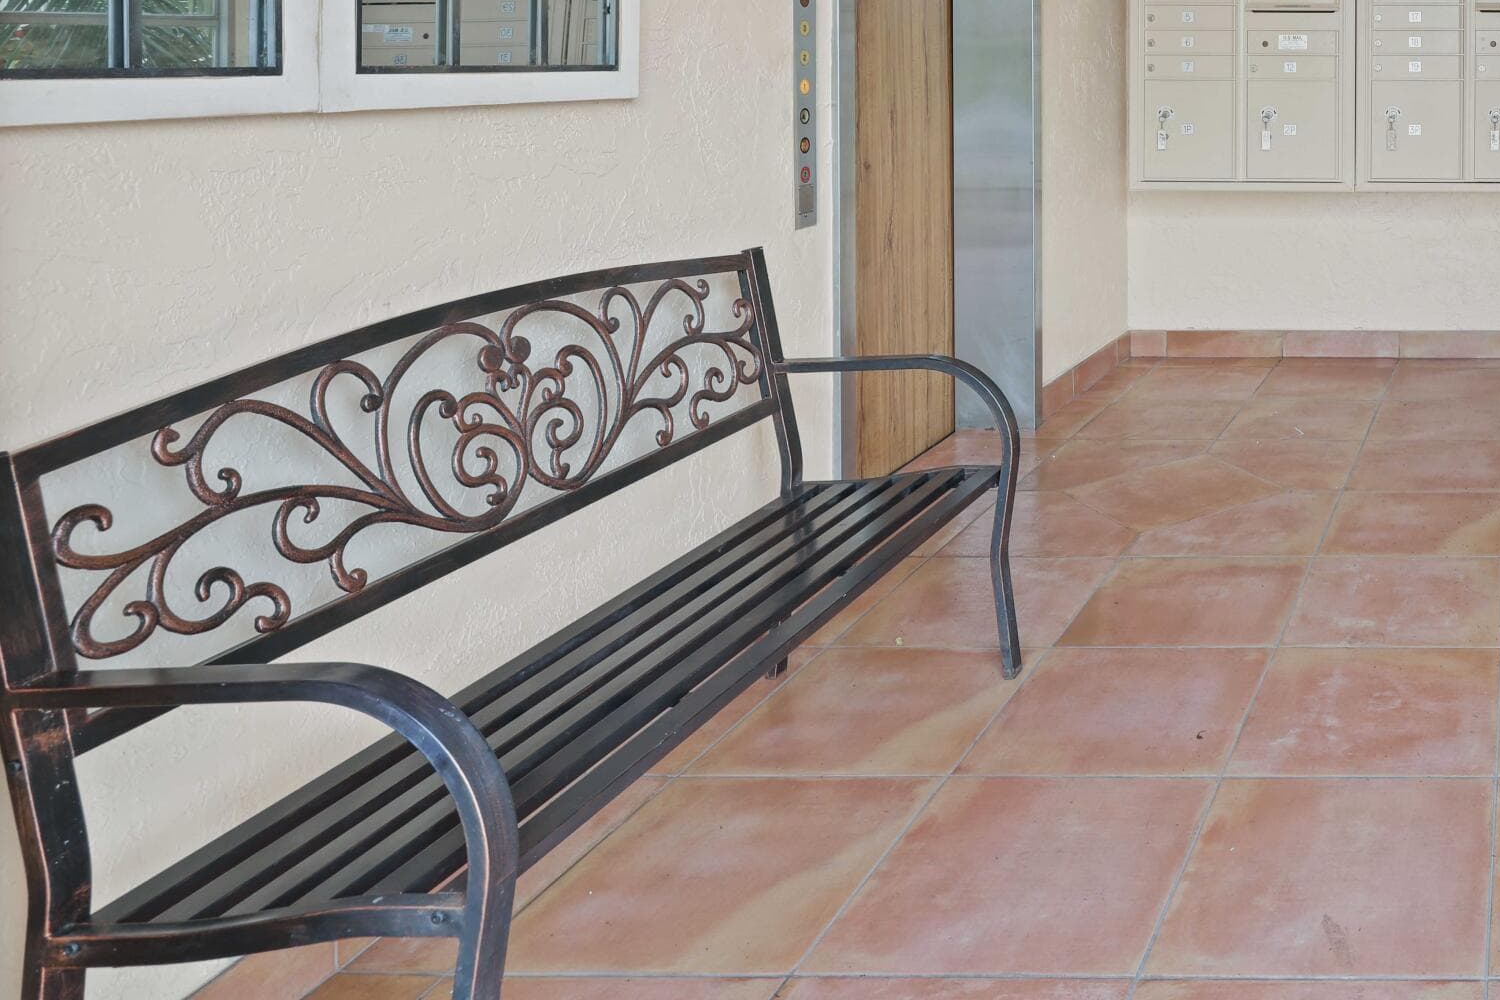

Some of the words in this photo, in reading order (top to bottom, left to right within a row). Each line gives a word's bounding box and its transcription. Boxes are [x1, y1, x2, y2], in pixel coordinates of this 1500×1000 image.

[1186, 13, 1190, 21] 5
[1186, 38, 1190, 46] 6
[1412, 38, 1418, 46] 18
[1412, 63, 1418, 71] 19
[1184, 125, 1192, 133] 1P
[1285, 126, 1295, 134] 2P
[1410, 126, 1419, 134] 3P
